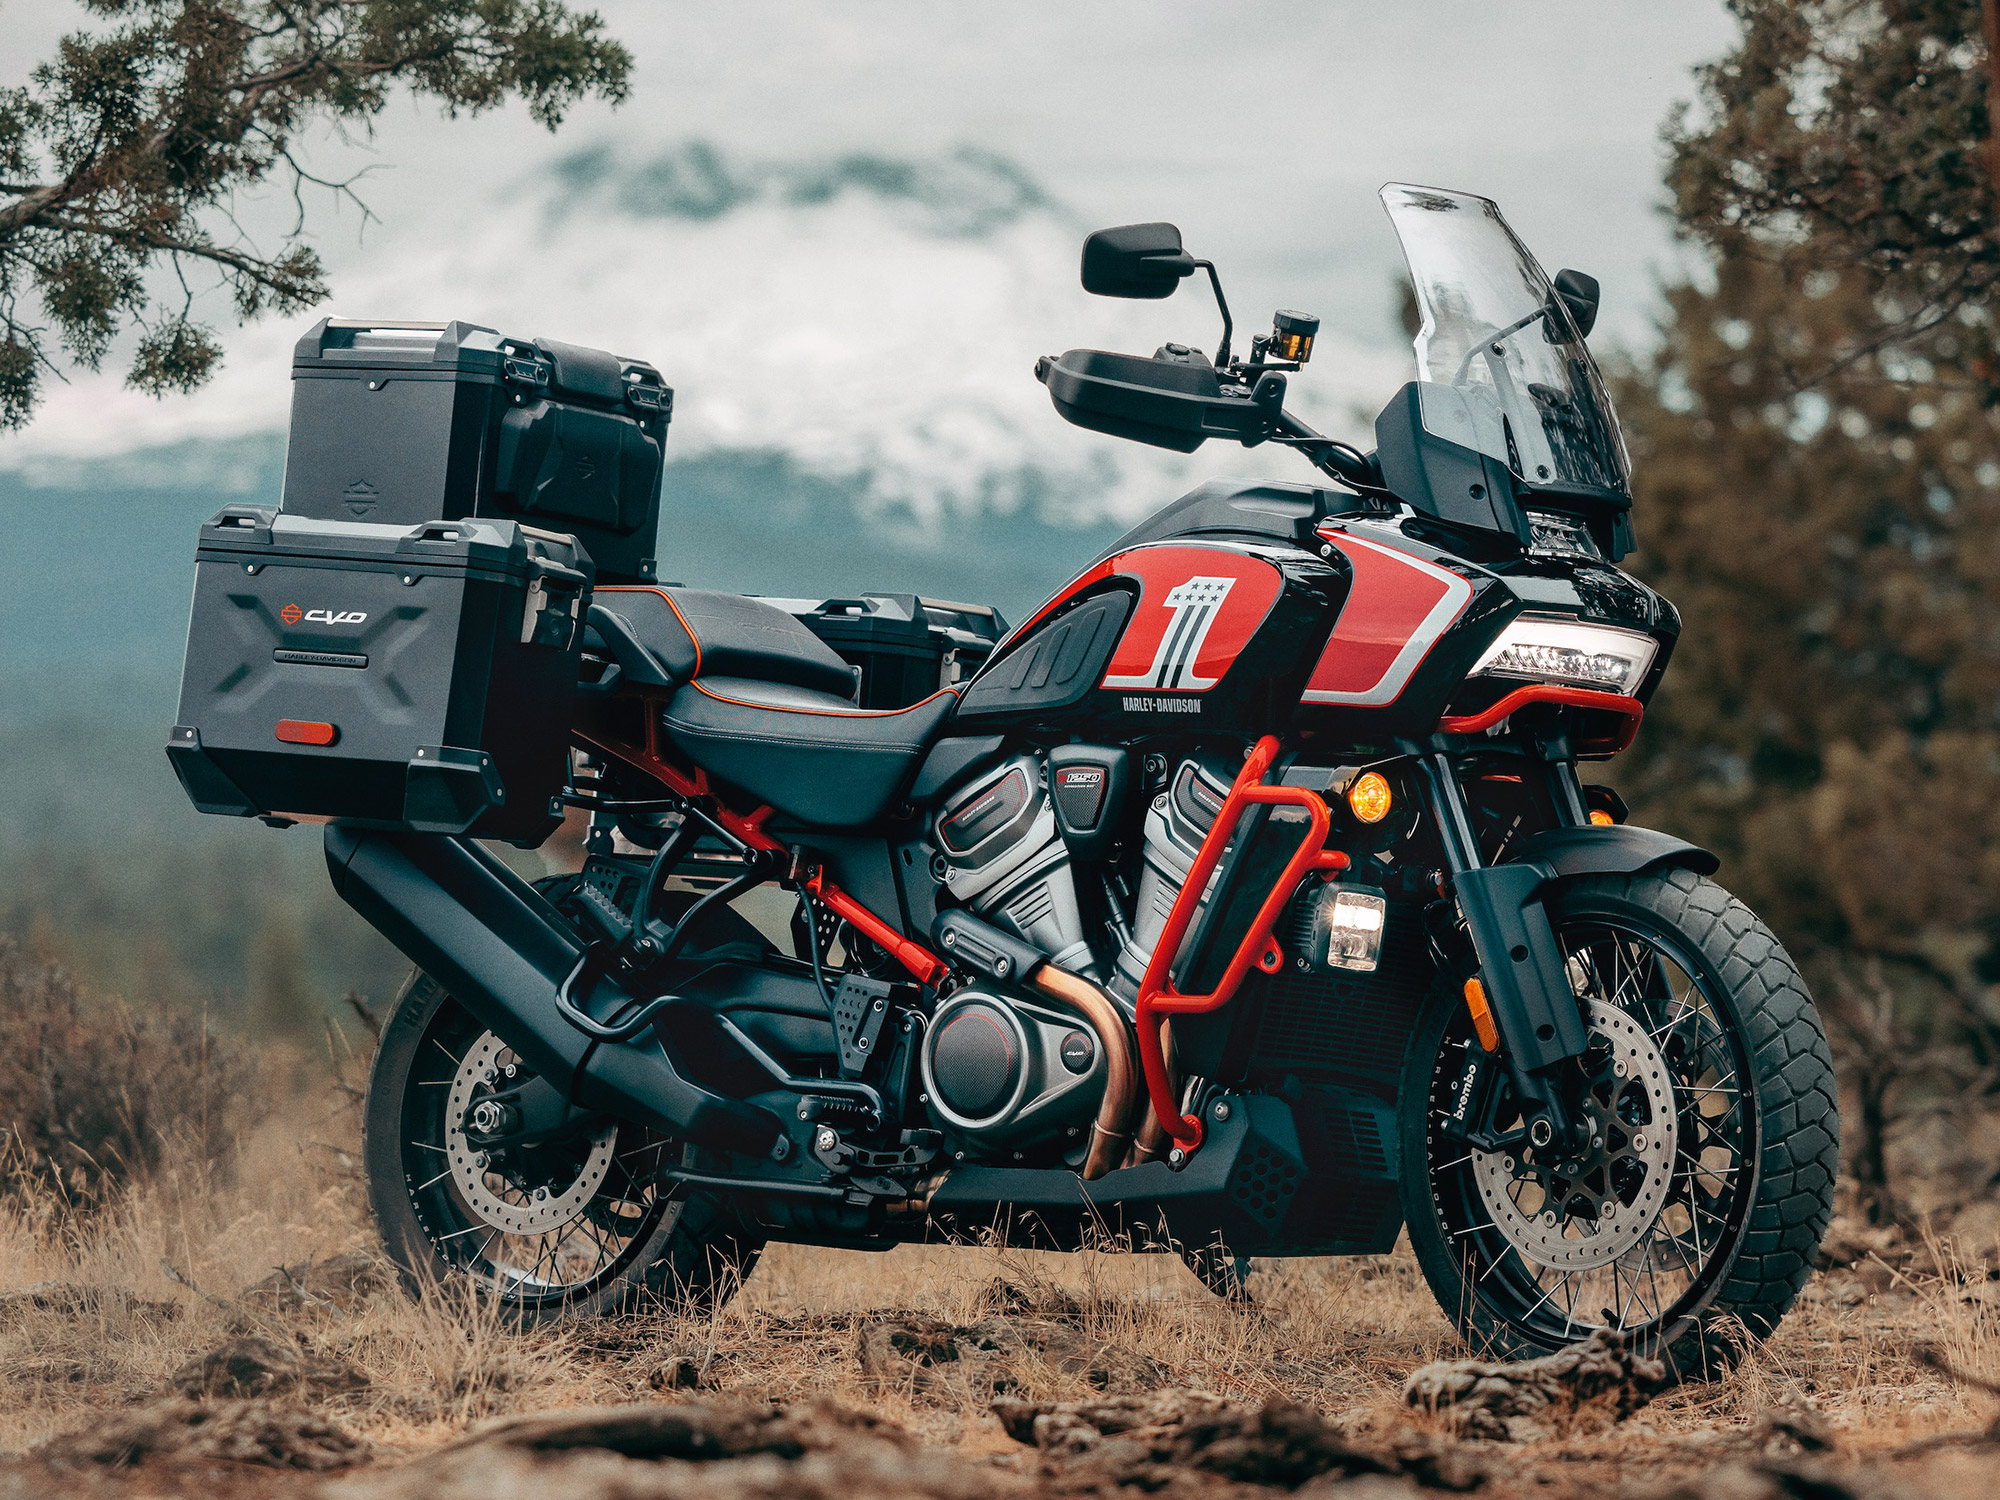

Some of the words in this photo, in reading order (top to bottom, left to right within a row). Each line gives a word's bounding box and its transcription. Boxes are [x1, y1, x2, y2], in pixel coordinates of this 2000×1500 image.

[304, 609, 368, 625] CVO
[1122, 697, 1201, 713] HARLEY-DAVIDSON
[1067, 773, 1101, 783] 1250
[1453, 1064, 1477, 1121] brembo
[1426, 1036, 1455, 1246] HARLEY-DAVIDSON
